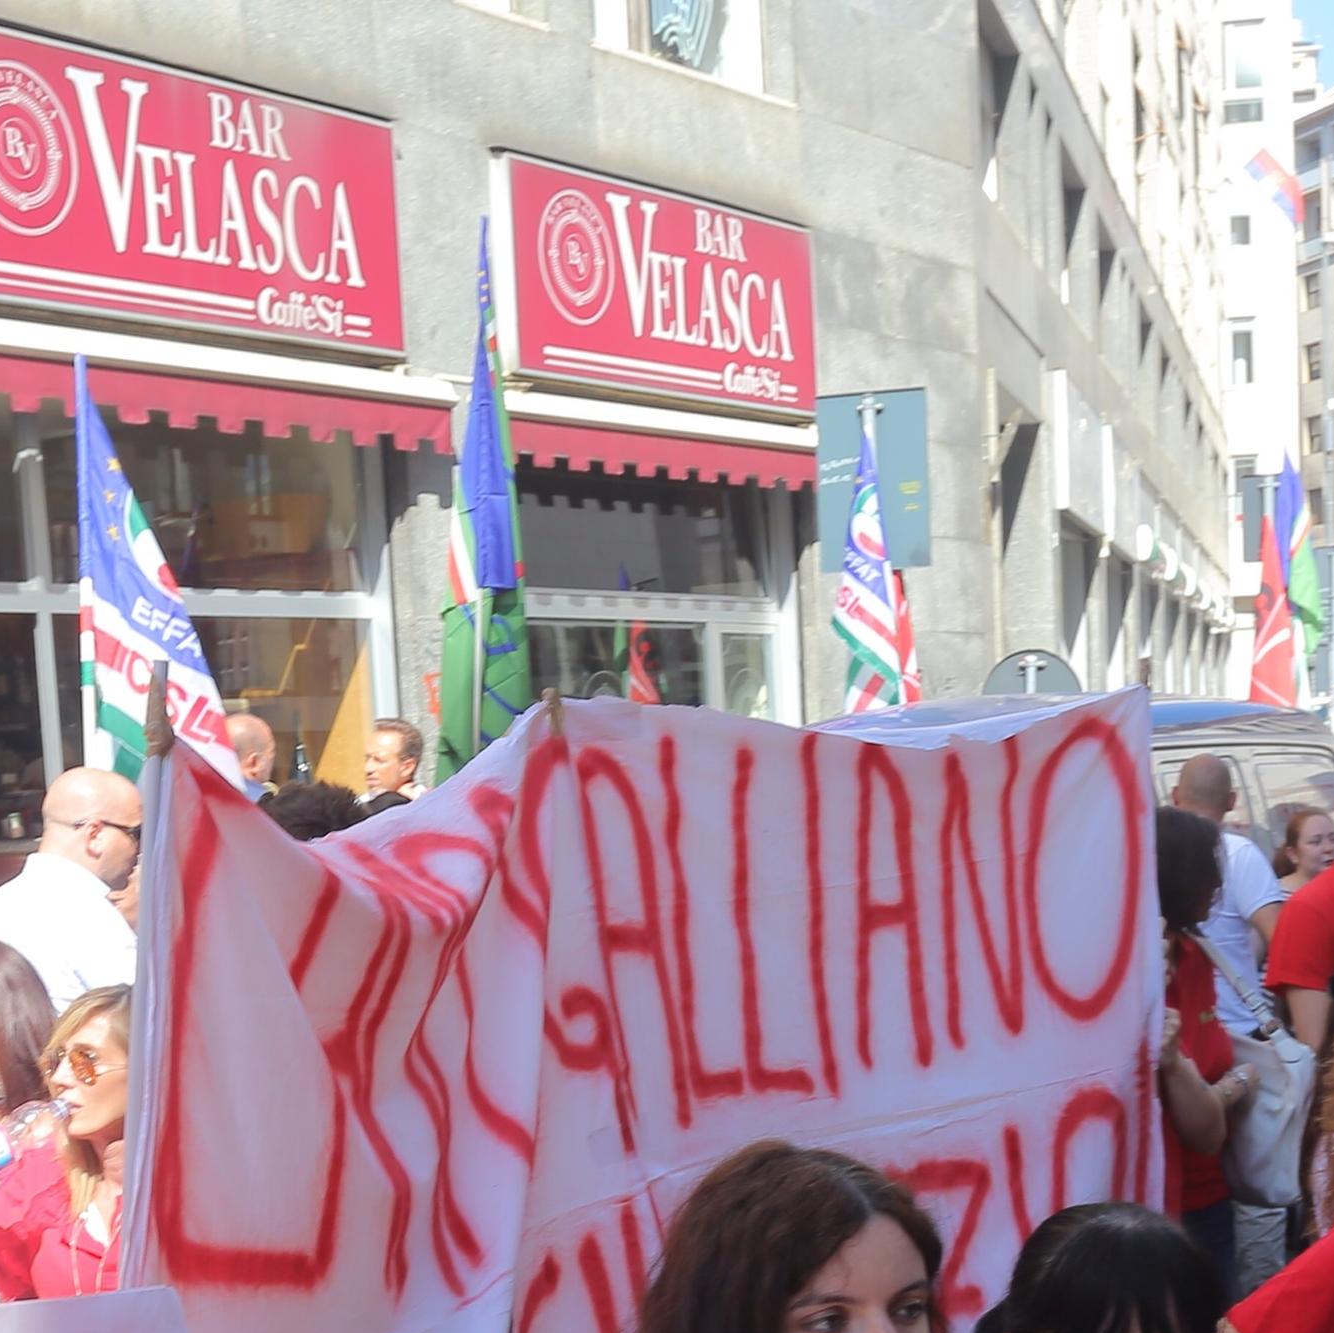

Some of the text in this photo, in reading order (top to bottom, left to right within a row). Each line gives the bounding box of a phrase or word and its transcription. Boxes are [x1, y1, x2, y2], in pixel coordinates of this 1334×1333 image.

[64, 65, 366, 288] VELASCA
[208, 92, 292, 162] BAR
[604, 191, 795, 362] VELASCA
[693, 208, 747, 262] BAR
